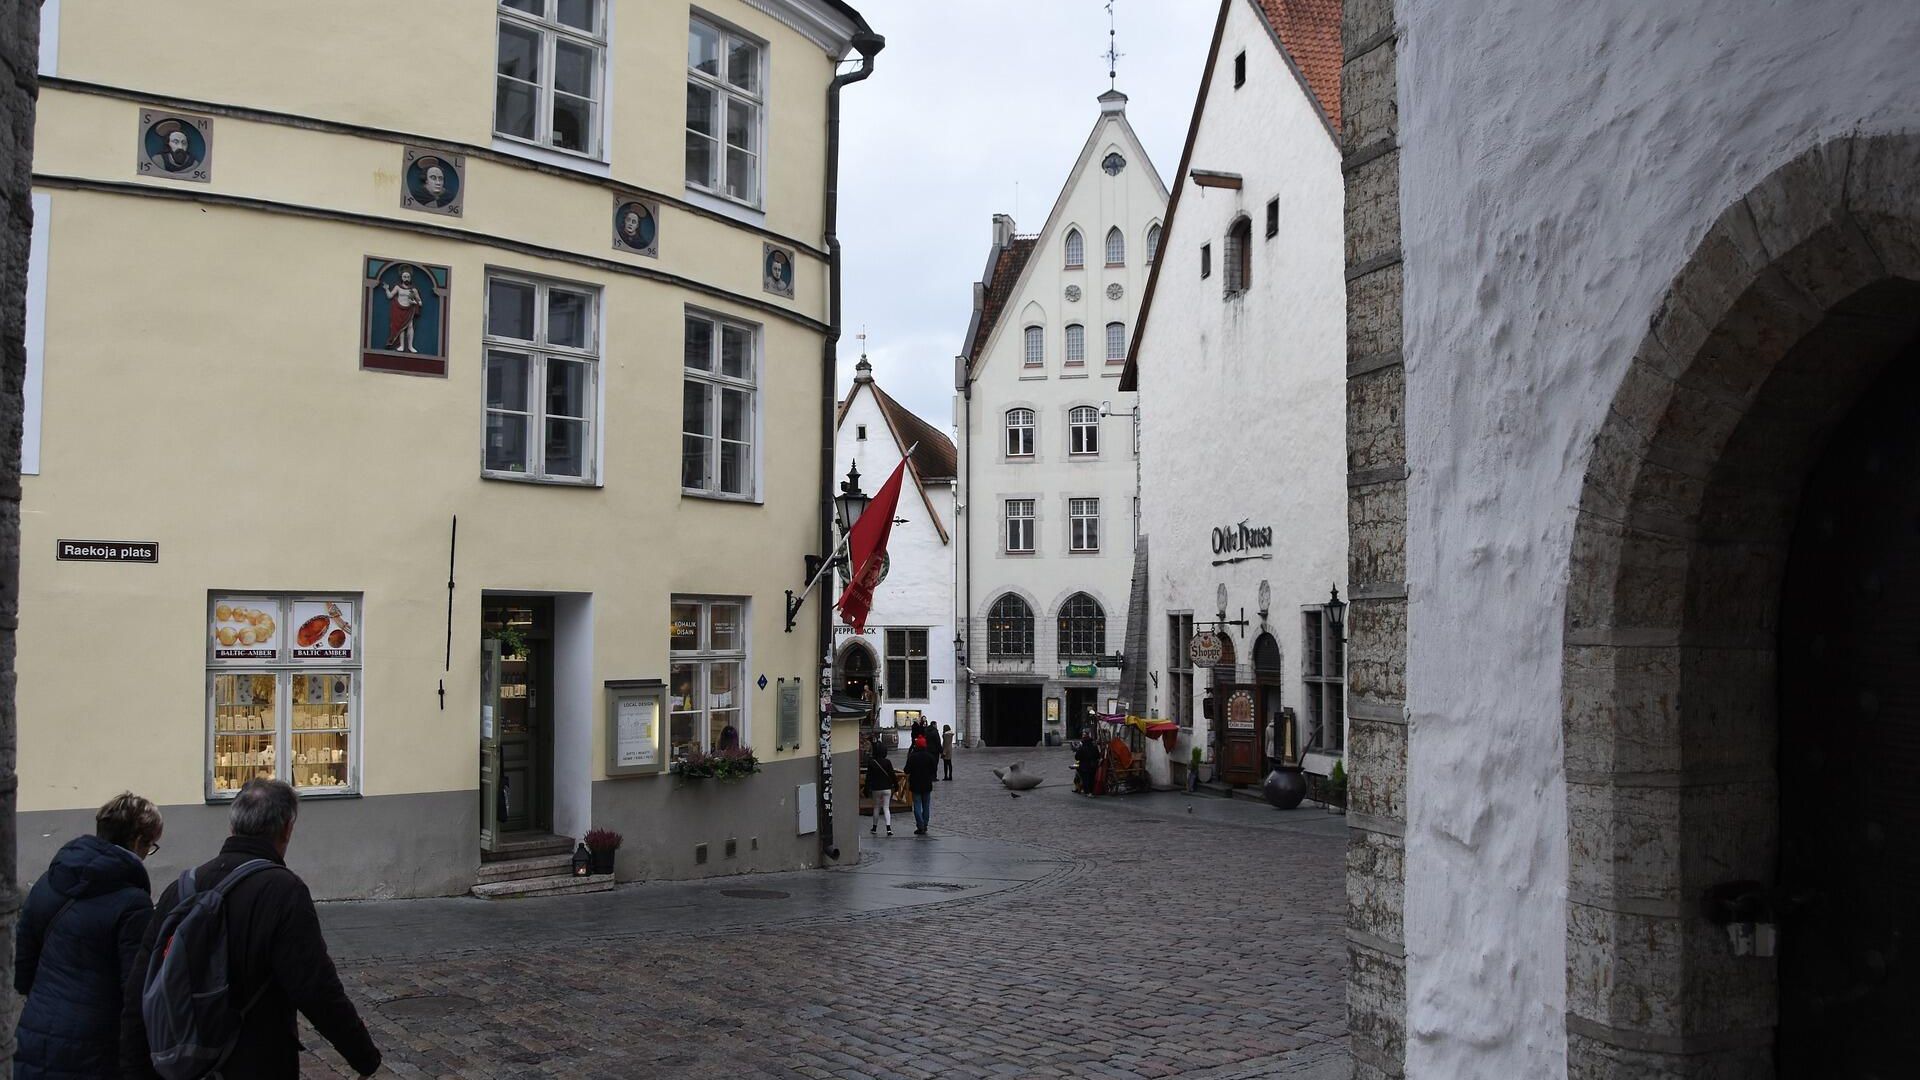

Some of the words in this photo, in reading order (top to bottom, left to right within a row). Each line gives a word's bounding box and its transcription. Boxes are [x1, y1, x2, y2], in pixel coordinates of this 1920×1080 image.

[144, 114, 151, 124] S
[197, 120, 207, 129] M
[408, 151, 414, 160] S
[455, 158, 461, 168] L
[140, 161, 153, 172] 15
[192, 170, 207, 179] 96
[403, 195, 415, 206] 15
[448, 205, 459, 214] 96
[64, 544, 117, 559] Raekoja
[120, 546, 152, 559] plats
[834, 627, 877, 635] PEPPEACK
